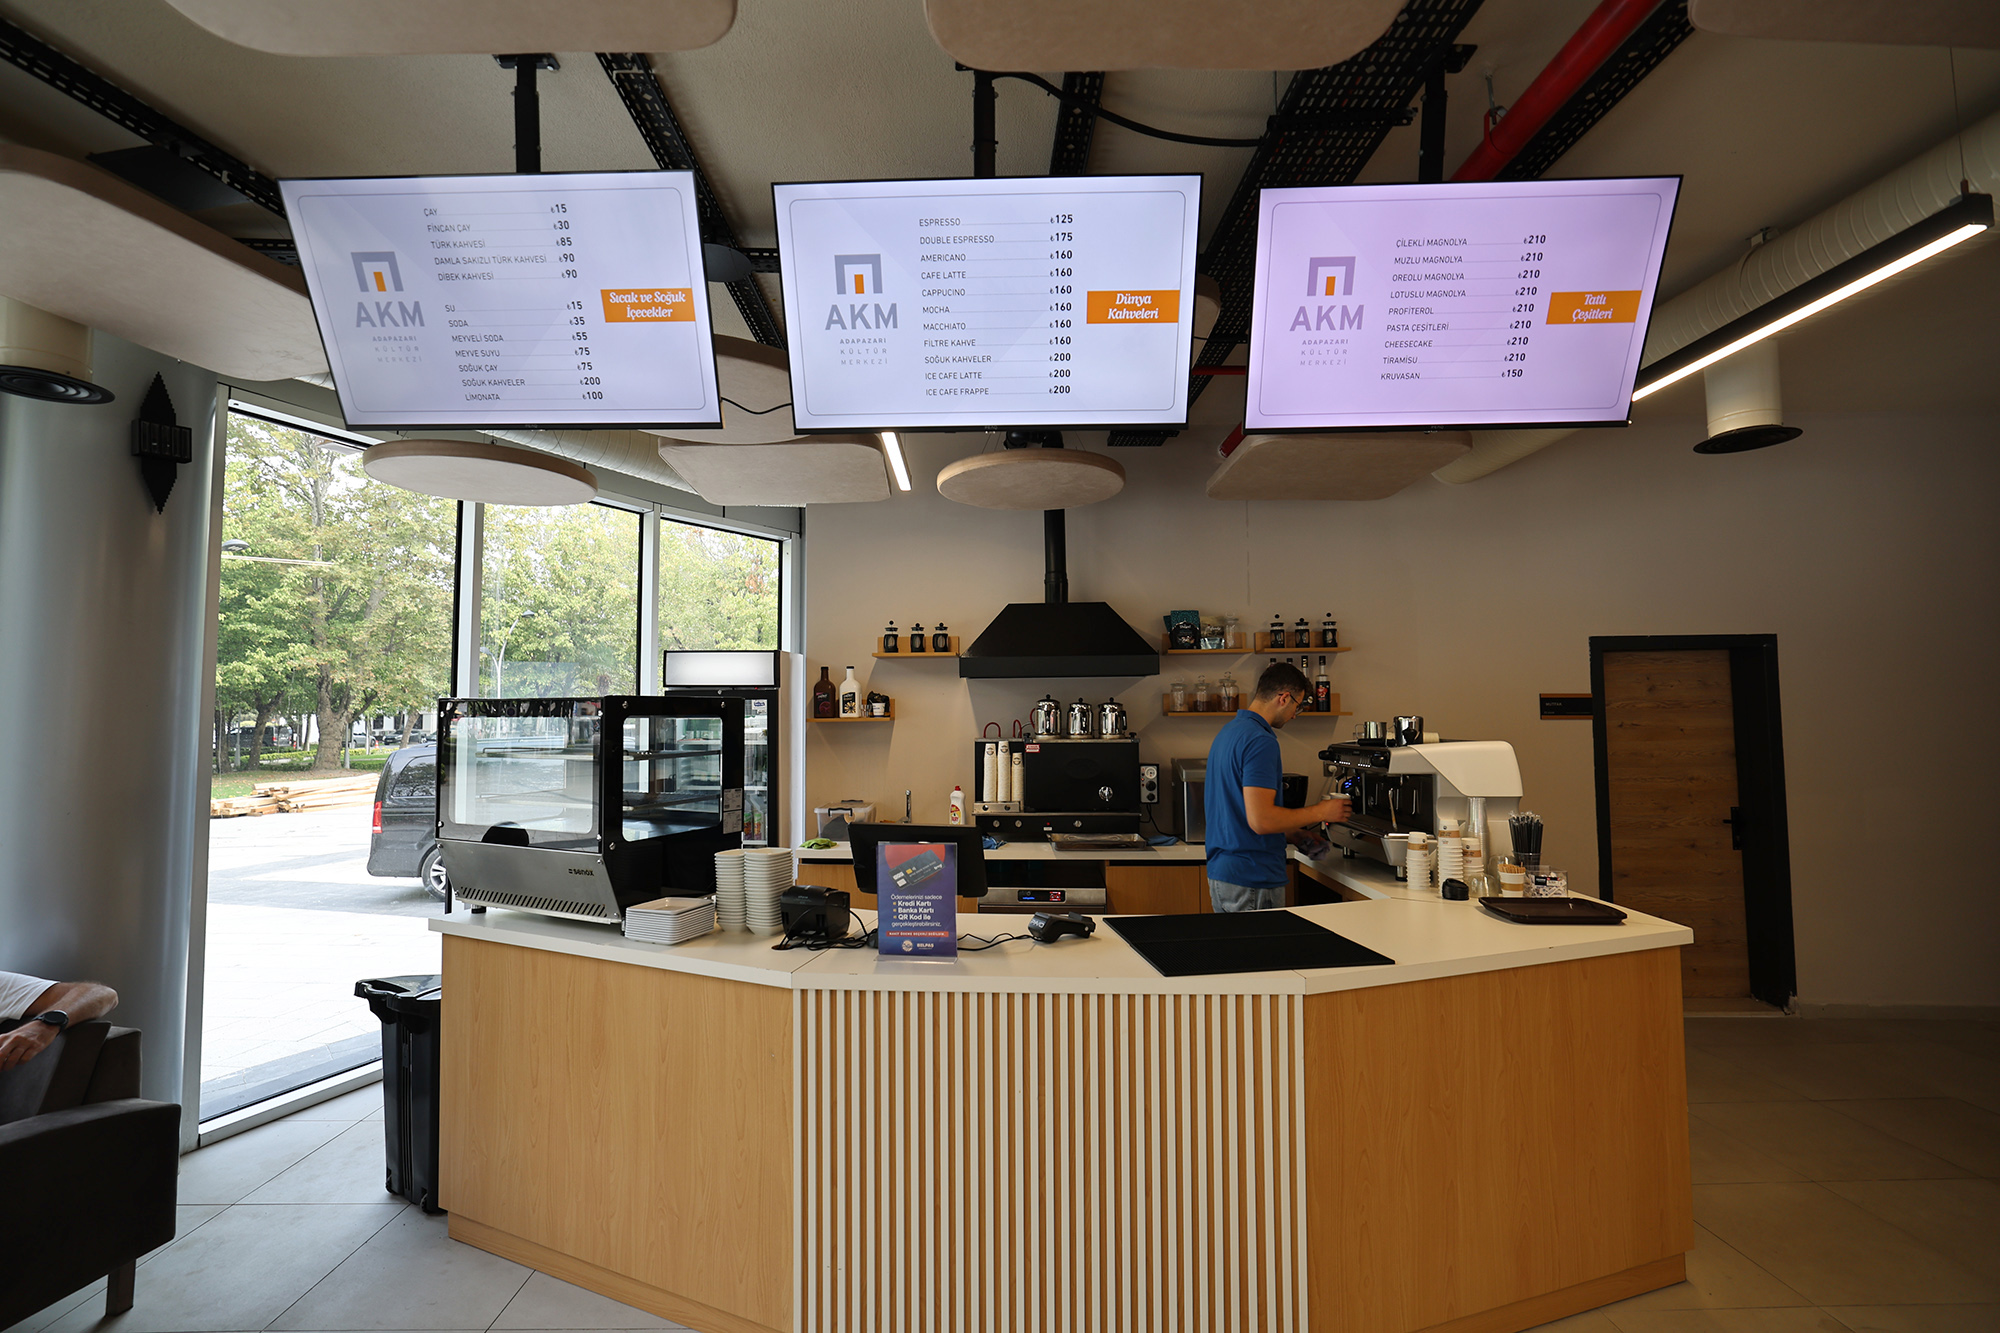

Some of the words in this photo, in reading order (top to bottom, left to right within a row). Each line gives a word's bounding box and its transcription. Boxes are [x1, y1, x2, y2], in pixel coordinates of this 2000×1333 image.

[424, 207, 438, 218] ÇAY
[919, 218, 961, 226] ESPRESSO
[427, 223, 454, 233] FİNCAN
[455, 223, 470, 233] ÇAY
[431, 239, 451, 248] TÜRK
[453, 239, 485, 248] KAHVESİ
[920, 236, 951, 245] DOUBLE
[953, 235, 994, 244] ESPRESSO
[1396, 237, 1425, 248] ÇİLEKLİ
[1427, 237, 1468, 246] MAGNOLYA
[435, 256, 460, 265] DAMLA
[462, 255, 491, 264] SAKIZLI
[492, 254, 513, 264] TÜRK
[514, 254, 547, 264] KAHVESİ
[921, 253, 966, 262] AMERICANO
[1394, 256, 1420, 264] MUZLU
[1422, 255, 1463, 264] MAGNOLYA
[438, 272, 461, 281] DİBEK
[462, 271, 494, 281] KAHVESİ
[921, 271, 941, 279] CAFE
[943, 271, 966, 279] LATTE
[1392, 273, 1422, 282] OREOLU
[1424, 272, 1465, 281] MAGNOLYA
[922, 288, 965, 297] CAPPUCINO
[1390, 290, 1424, 299] LOTUSLU
[1425, 289, 1466, 298] MAGNOLYA
[610, 292, 637, 303] Sıcak
[654, 291, 685, 304] Soğuk
[1116, 293, 1152, 307] Dünya
[1584, 293, 1607, 305] Tatlı
[445, 304, 455, 312] SU
[626, 305, 672, 320] İçecekler
[1388, 306, 1434, 315] PROFİTEROL
[356, 301, 424, 328] AKM
[825, 303, 898, 330] AKM
[1108, 306, 1158, 320] Kahveleri
[1572, 307, 1612, 321] Çeşitleri
[1289, 305, 1364, 331] AKM
[449, 319, 468, 327] SODA
[924, 322, 966, 331] MACCHIATO
[1386, 324, 1410, 332] PASTA
[1411, 322, 1449, 333] ÇEŞİTLERİ
[452, 334, 482, 343] MEYVELİ
[484, 334, 503, 342] SODA
[924, 338, 950, 347] FİLTRE
[951, 339, 976, 347] KAHVE
[375, 344, 419, 353] KÜLTÜR
[1384, 340, 1433, 348] CHEESECAKE
[455, 350, 478, 358] MEYVE
[480, 349, 500, 358] SUYU
[840, 347, 887, 355] KÜLTÜR
[1301, 348, 1348, 356] KÜLTÜR
[841, 357, 888, 365] MERKEZİ
[925, 354, 951, 364] SOĞUK
[953, 354, 992, 363] KAHVELER
[1300, 358, 1347, 366] MERKEZİ
[1382, 356, 1418, 364] TİRAMİSU
[459, 363, 482, 373] SOĞUK
[484, 364, 498, 373] ÇAY
[925, 372, 936, 380] ICE
[938, 372, 957, 380] CAFE
[959, 371, 982, 379] LATTE
[1381, 372, 1421, 380] KRUVASAN
[462, 377, 486, 387] SOĞUK
[488, 378, 525, 387] KAHVELER
[465, 392, 500, 401] LİMONATA
[960, 388, 989, 396] FRAPPE
